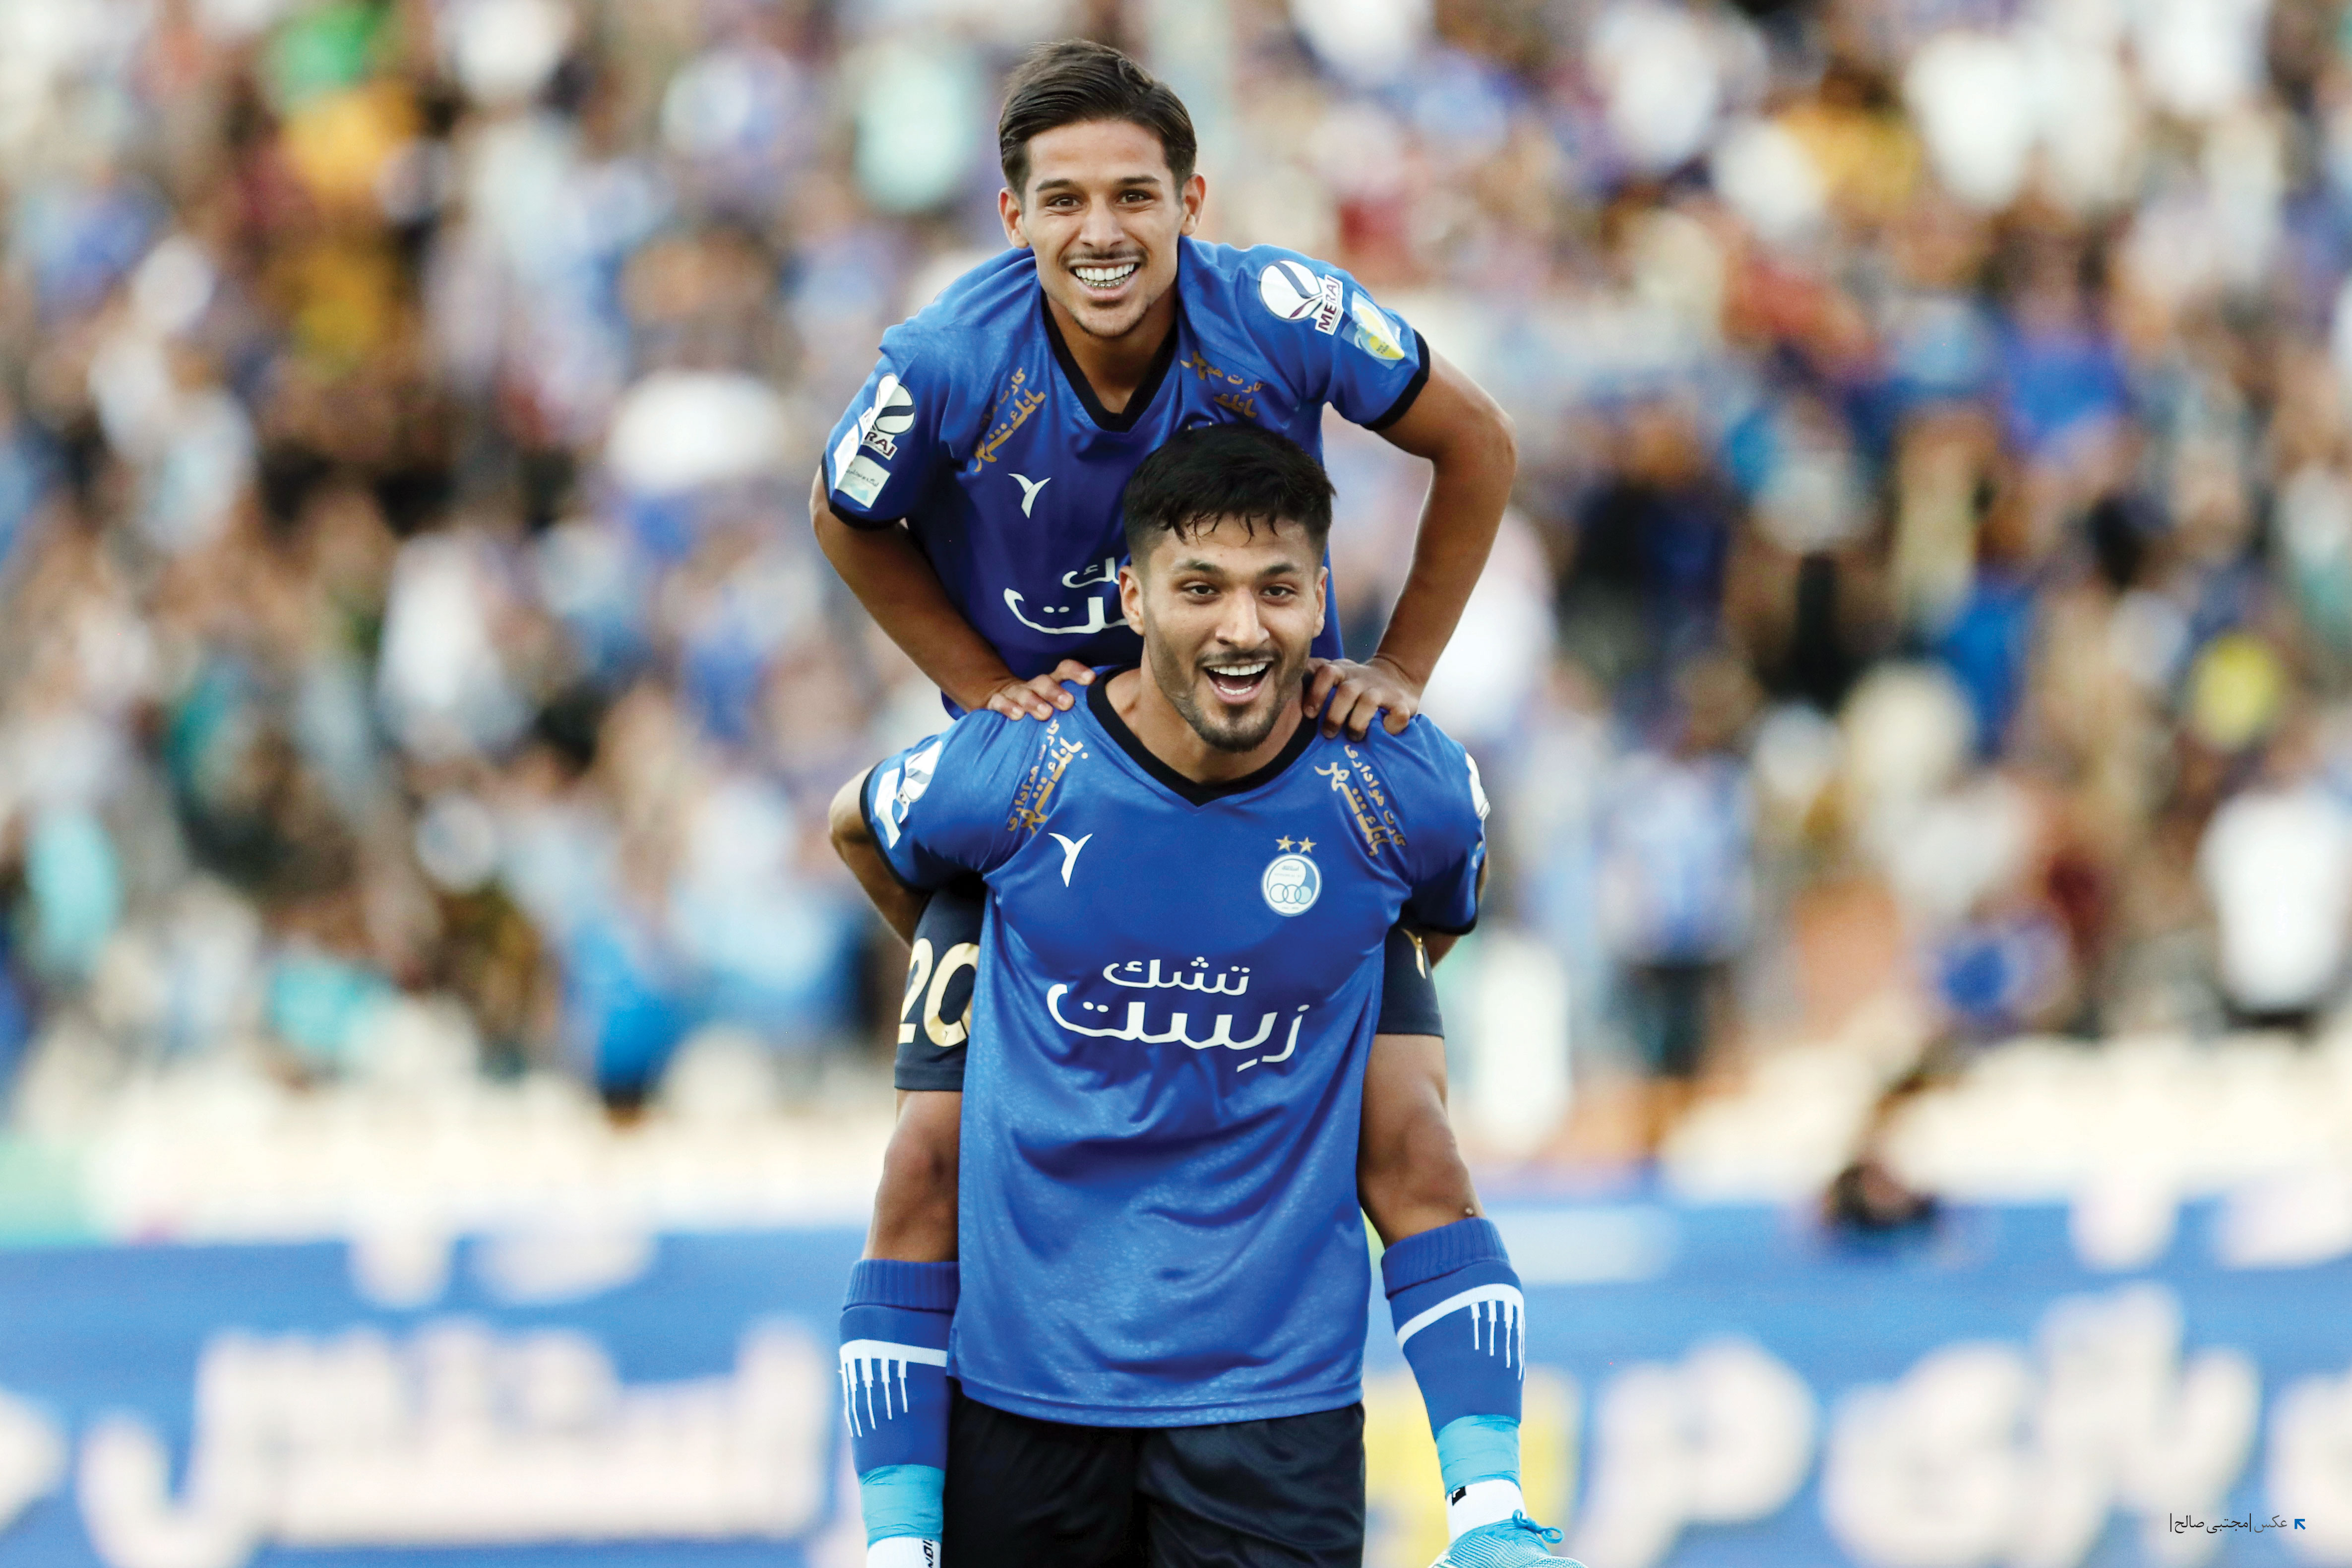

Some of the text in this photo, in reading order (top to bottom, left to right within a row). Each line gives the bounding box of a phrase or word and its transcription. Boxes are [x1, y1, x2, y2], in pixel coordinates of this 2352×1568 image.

[1317, 275, 1341, 331] MERAJ
[898, 938, 980, 1047] 20
[1103, 956, 1250, 996] تشک
[1047, 983, 1310, 1072] زیست
